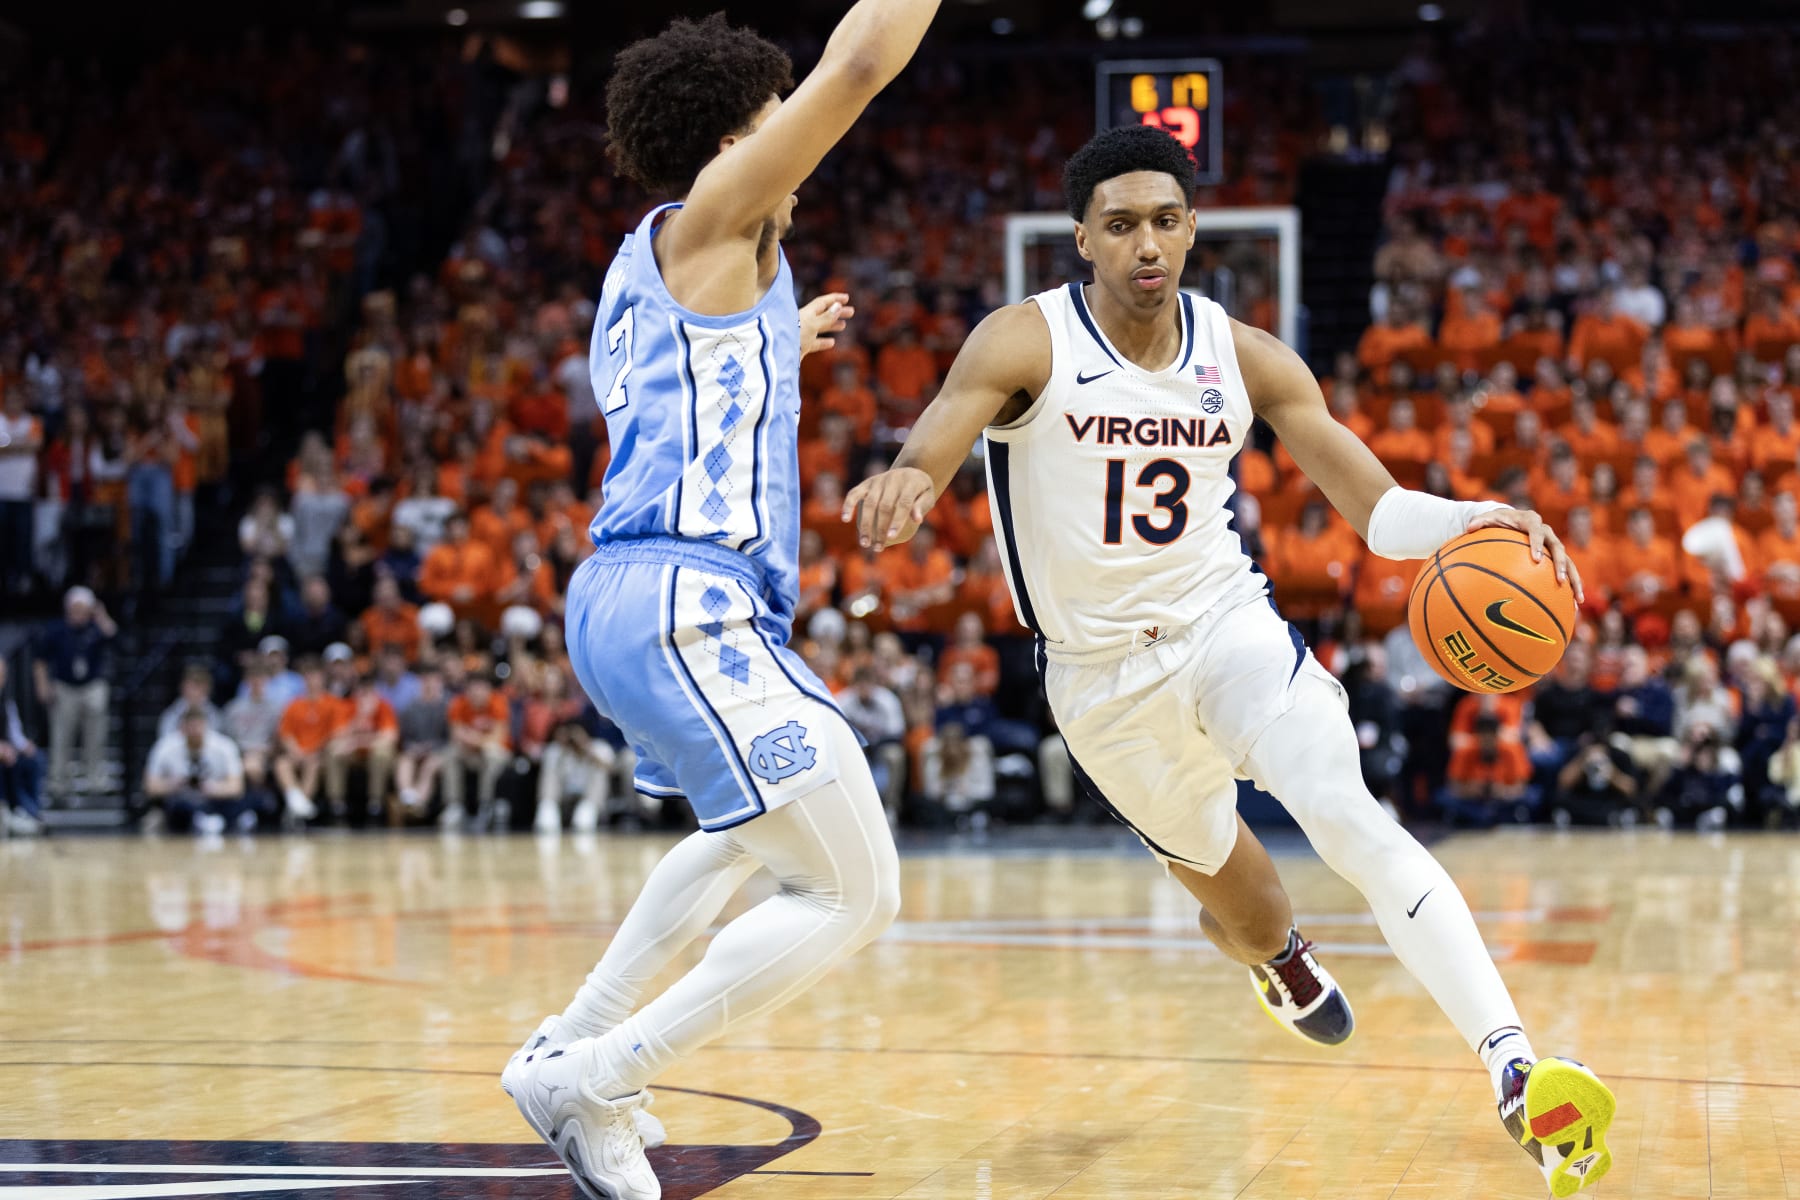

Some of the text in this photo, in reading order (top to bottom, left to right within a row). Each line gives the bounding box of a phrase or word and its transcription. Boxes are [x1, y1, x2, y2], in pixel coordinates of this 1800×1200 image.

[605, 303, 635, 416] 7
[1064, 412, 1232, 447] VIRGINIA
[1103, 457, 1191, 546] 13
[1443, 629, 1516, 690] ELITE
